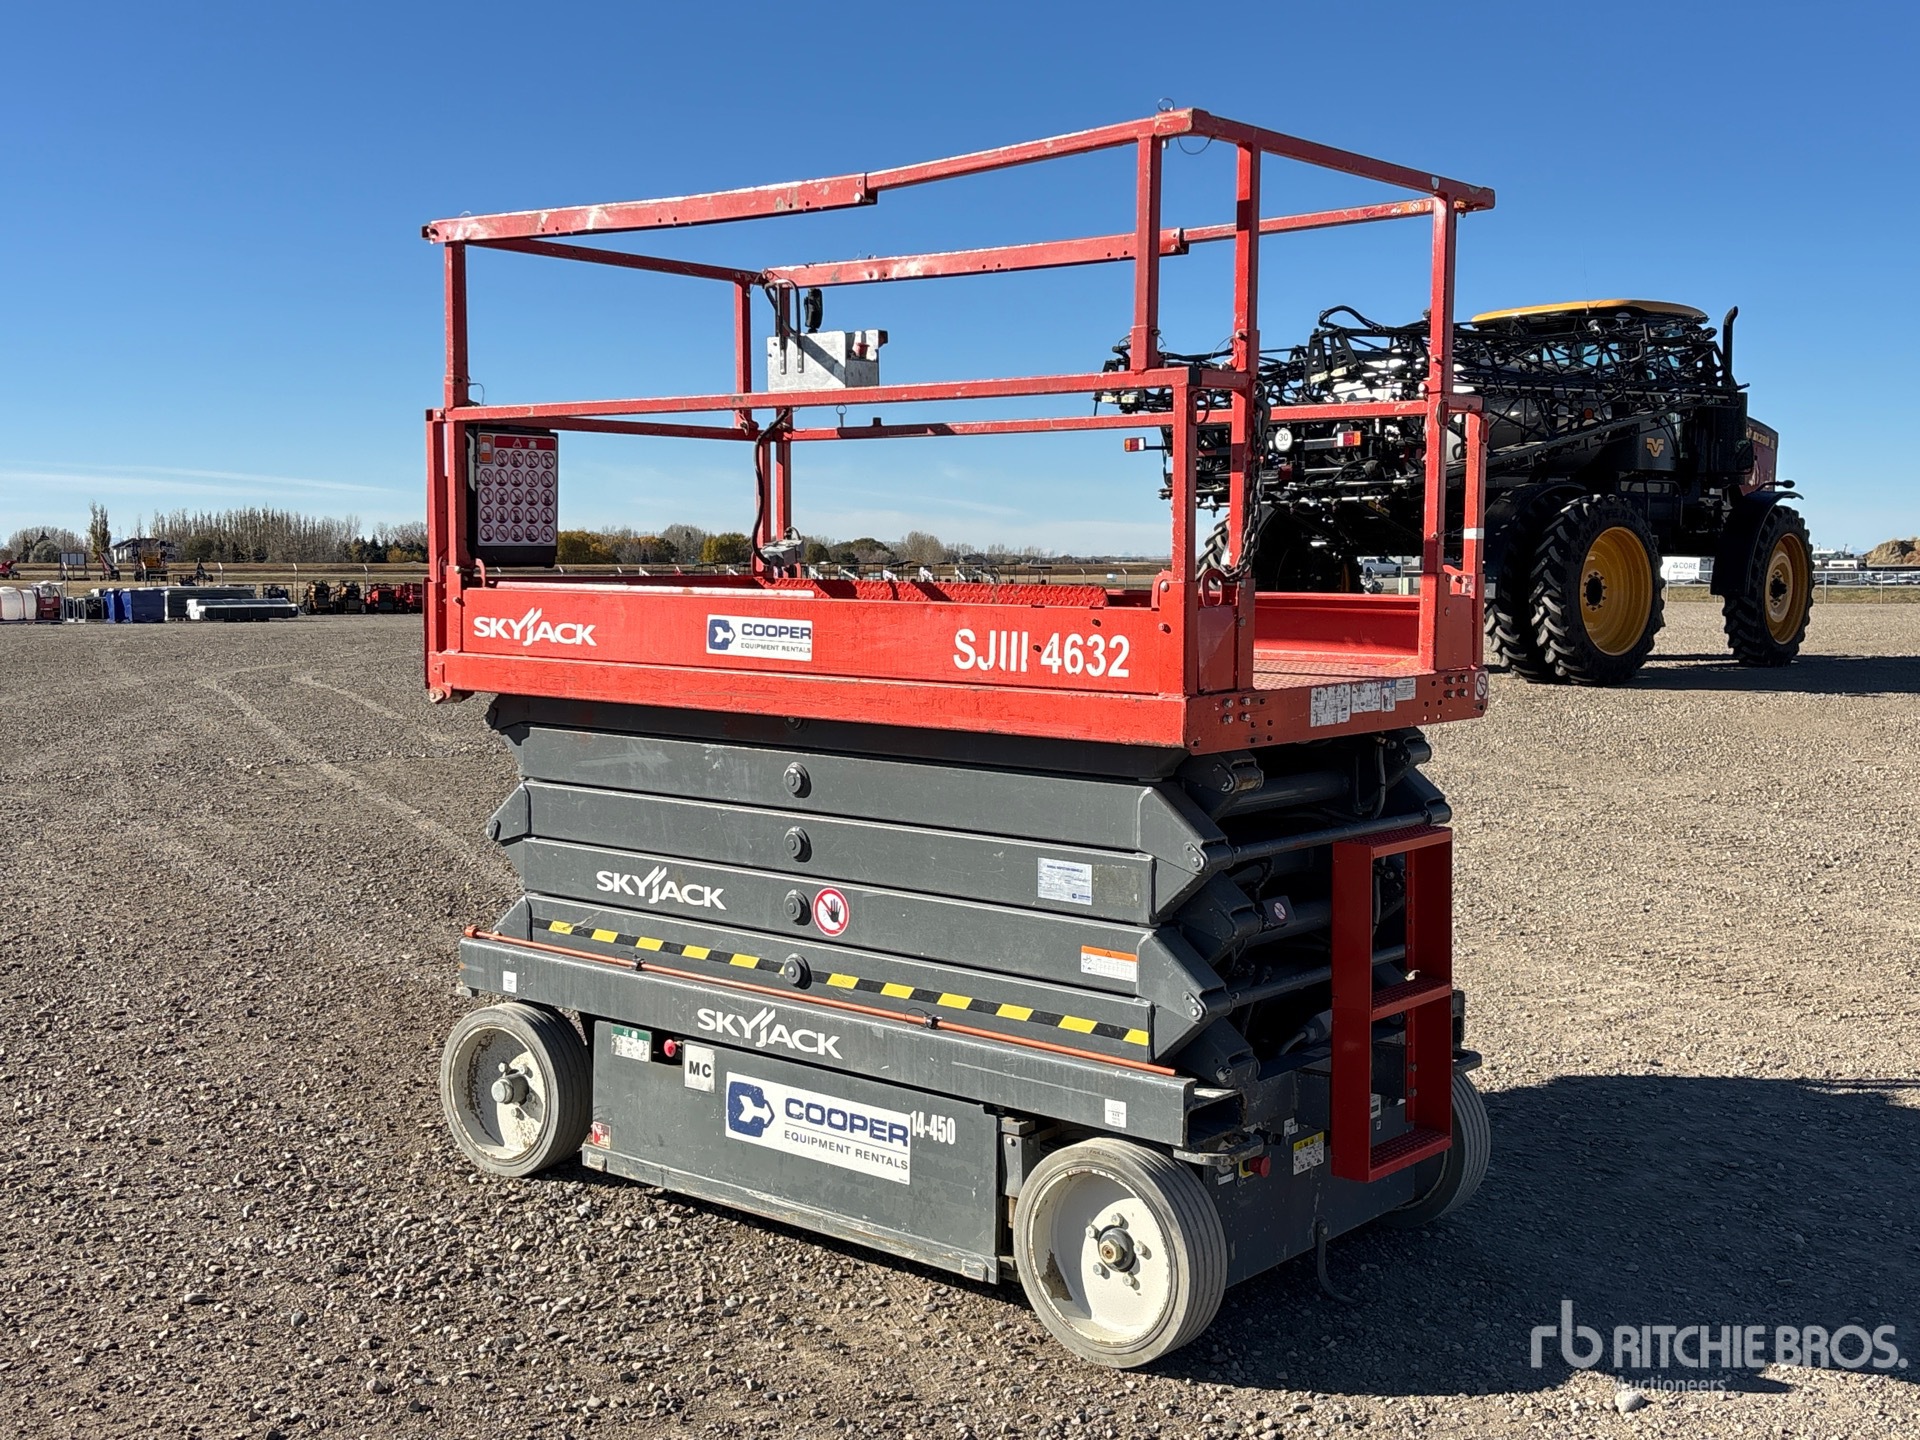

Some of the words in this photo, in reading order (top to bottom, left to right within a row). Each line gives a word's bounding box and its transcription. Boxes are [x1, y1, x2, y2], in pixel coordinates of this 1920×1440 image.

[1279, 433, 1289, 441] 30
[1679, 561, 1697, 570] CORE
[473, 607, 597, 647] SKYJACK
[741, 623, 812, 640] COOPER
[740, 642, 780, 652] EQUIPMENT
[781, 645, 812, 654] RENTALS
[953, 628, 1029, 673] SJIII
[1040, 632, 1131, 678] 4632
[596, 865, 727, 910] SKYJACK
[697, 1007, 843, 1060] SKYJACK
[688, 1060, 712, 1078] MC
[785, 1097, 909, 1147] COOPER
[909, 1110, 957, 1145] 14-450
[784, 1130, 852, 1155] EQUIPMENT
[855, 1148, 909, 1170] RENTALS
